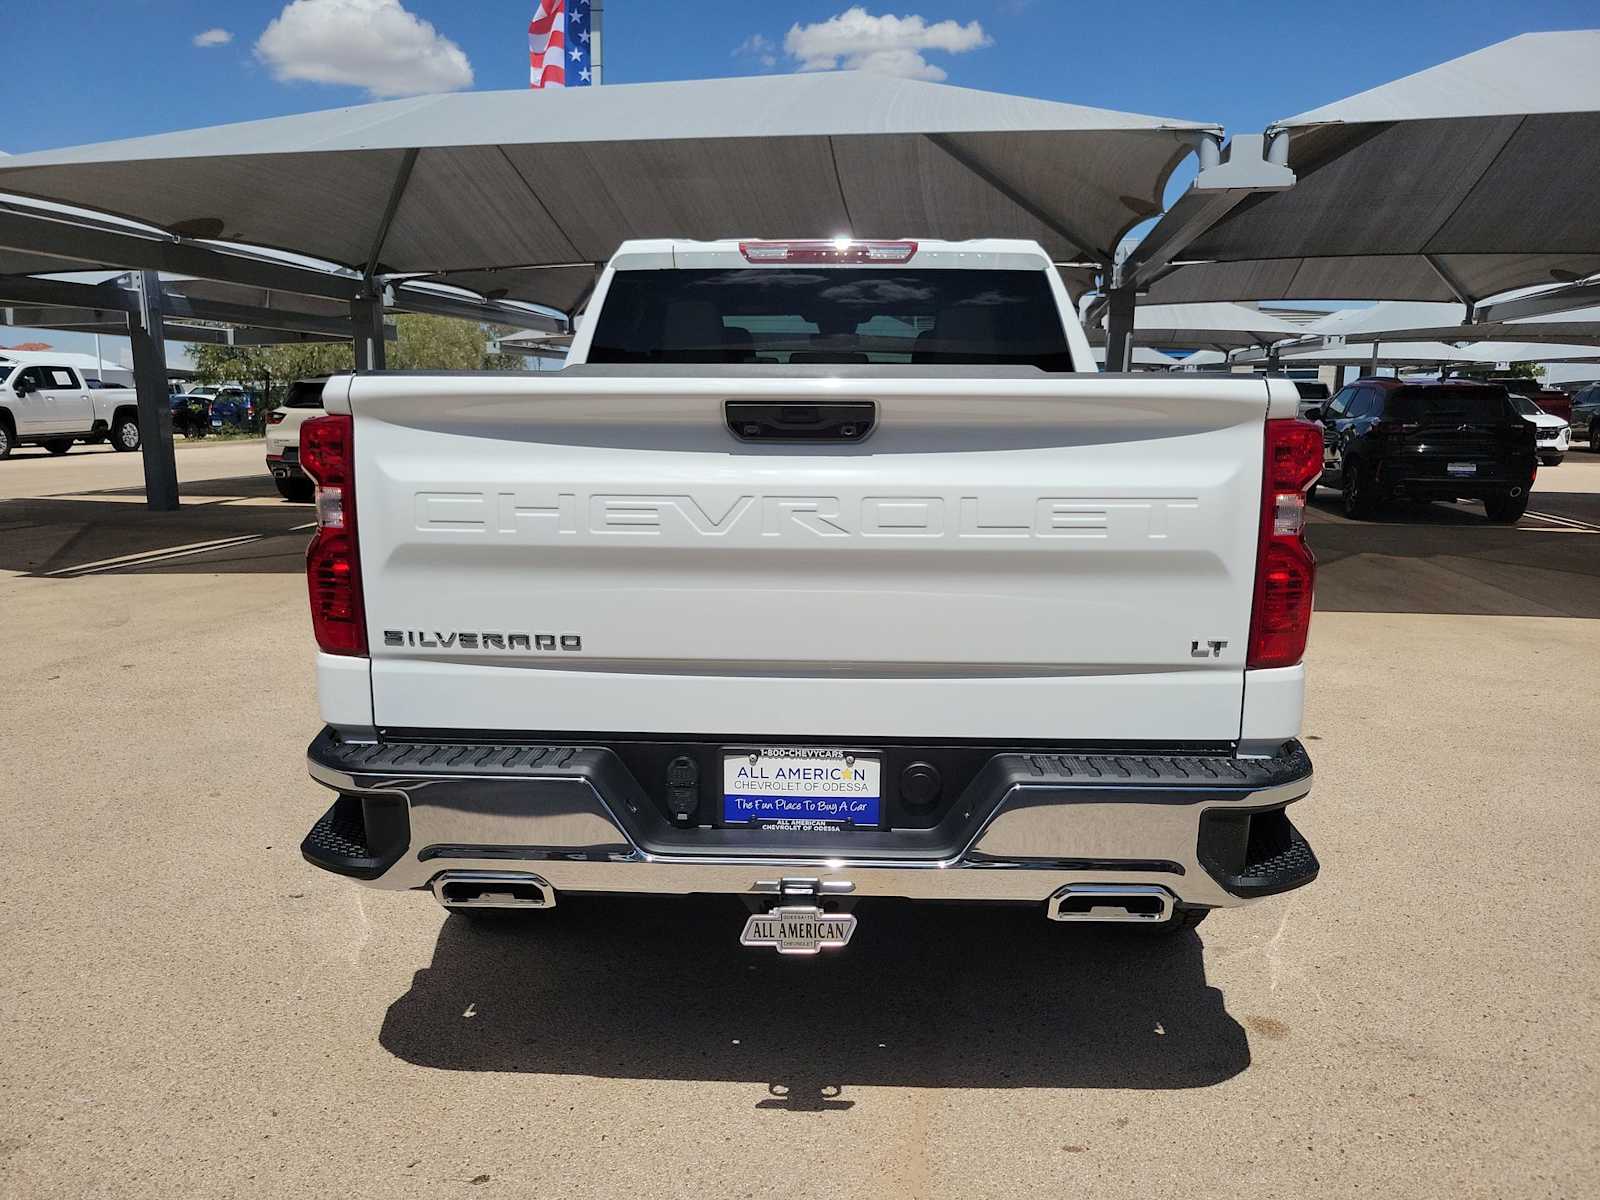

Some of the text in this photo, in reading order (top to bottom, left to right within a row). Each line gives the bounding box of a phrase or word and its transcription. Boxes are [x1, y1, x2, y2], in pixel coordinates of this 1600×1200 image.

[414, 491, 1198, 539] CHEVROLET
[384, 630, 582, 651] SILVERADO
[1191, 640, 1228, 657] LT
[761, 749, 844, 758] 1-800-CHEVYCARS
[737, 766, 770, 779] ALL
[734, 780, 869, 792] CHEVROLET OF ODESSA
[735, 798, 868, 815] The Fun Place To Buy A Car
[753, 922, 844, 939] ALL AMERICAN
